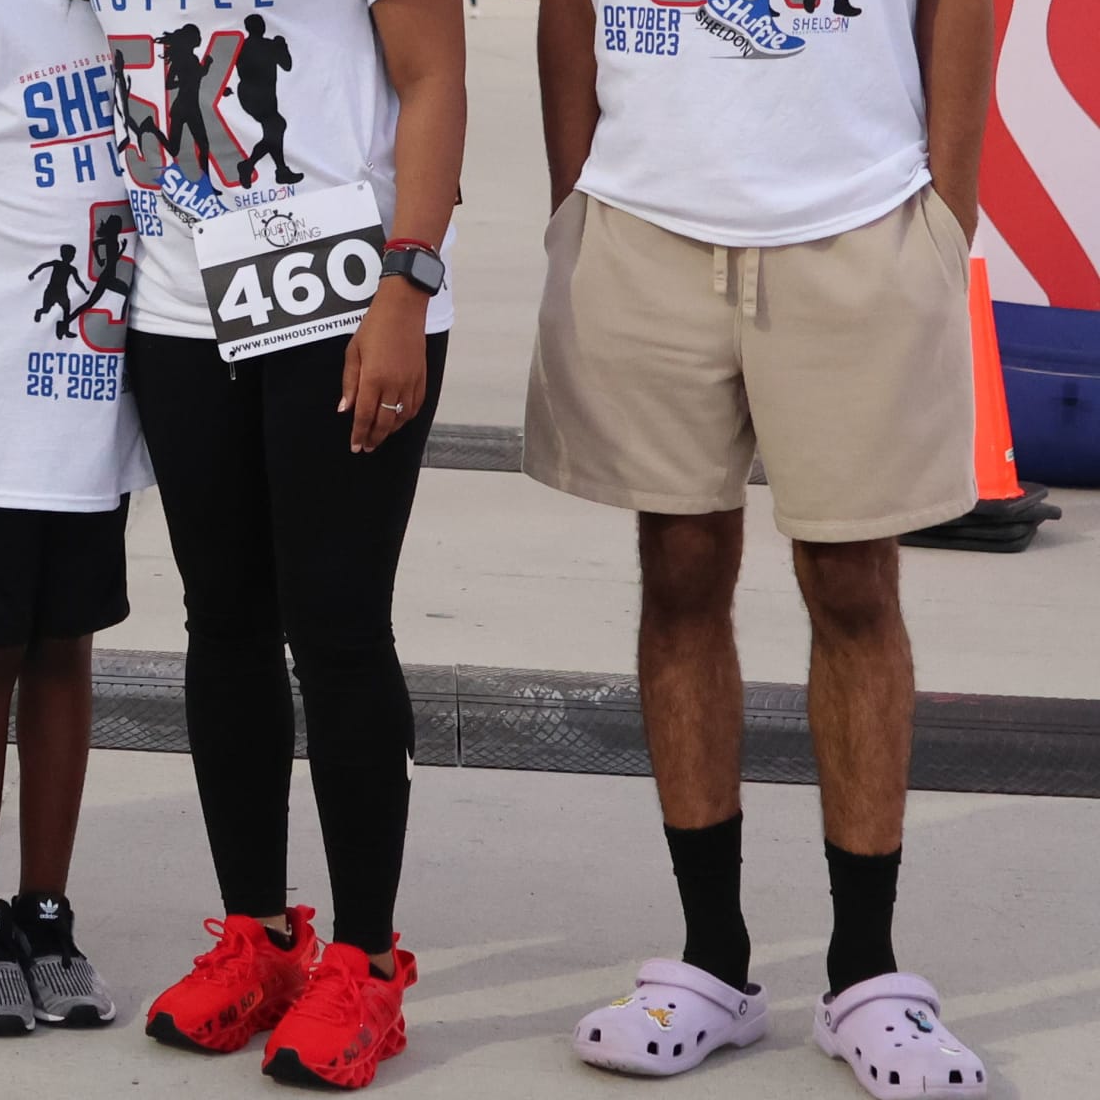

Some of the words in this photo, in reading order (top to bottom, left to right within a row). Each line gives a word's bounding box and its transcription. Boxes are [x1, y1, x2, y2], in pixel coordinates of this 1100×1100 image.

[603, 5, 682, 32] OCTOBER
[604, 29, 631, 55] 28,
[634, 31, 680, 57] 2023
[695, 9, 753, 58] SHELDON
[19, 63, 68, 84] SHELDON
[217, 238, 383, 327] 460
[231, 314, 366, 354] WWW.RUNHOUSTONTIMIN
[27, 351, 118, 378] OCTOBER
[26, 373, 59, 400] 28,
[66, 376, 118, 402] 2023
